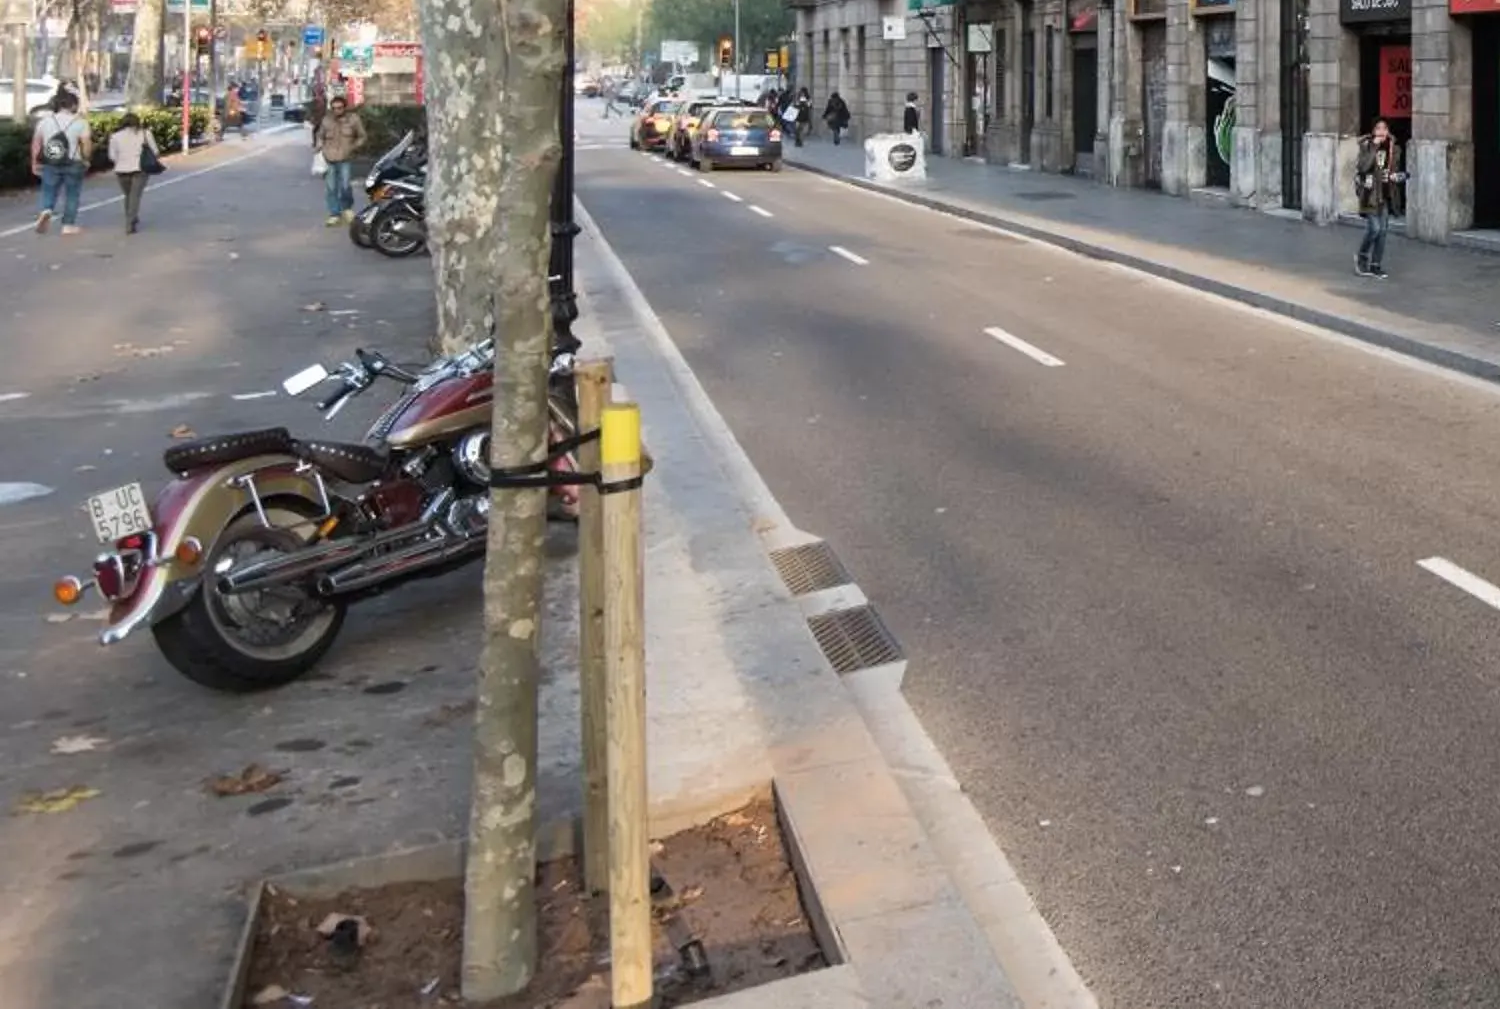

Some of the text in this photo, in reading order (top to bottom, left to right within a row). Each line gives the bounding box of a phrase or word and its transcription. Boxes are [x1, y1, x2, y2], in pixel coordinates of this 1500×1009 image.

[1388, 58, 1411, 74] SAL
[91, 485, 141, 518] B UC
[98, 508, 146, 542] 5796
